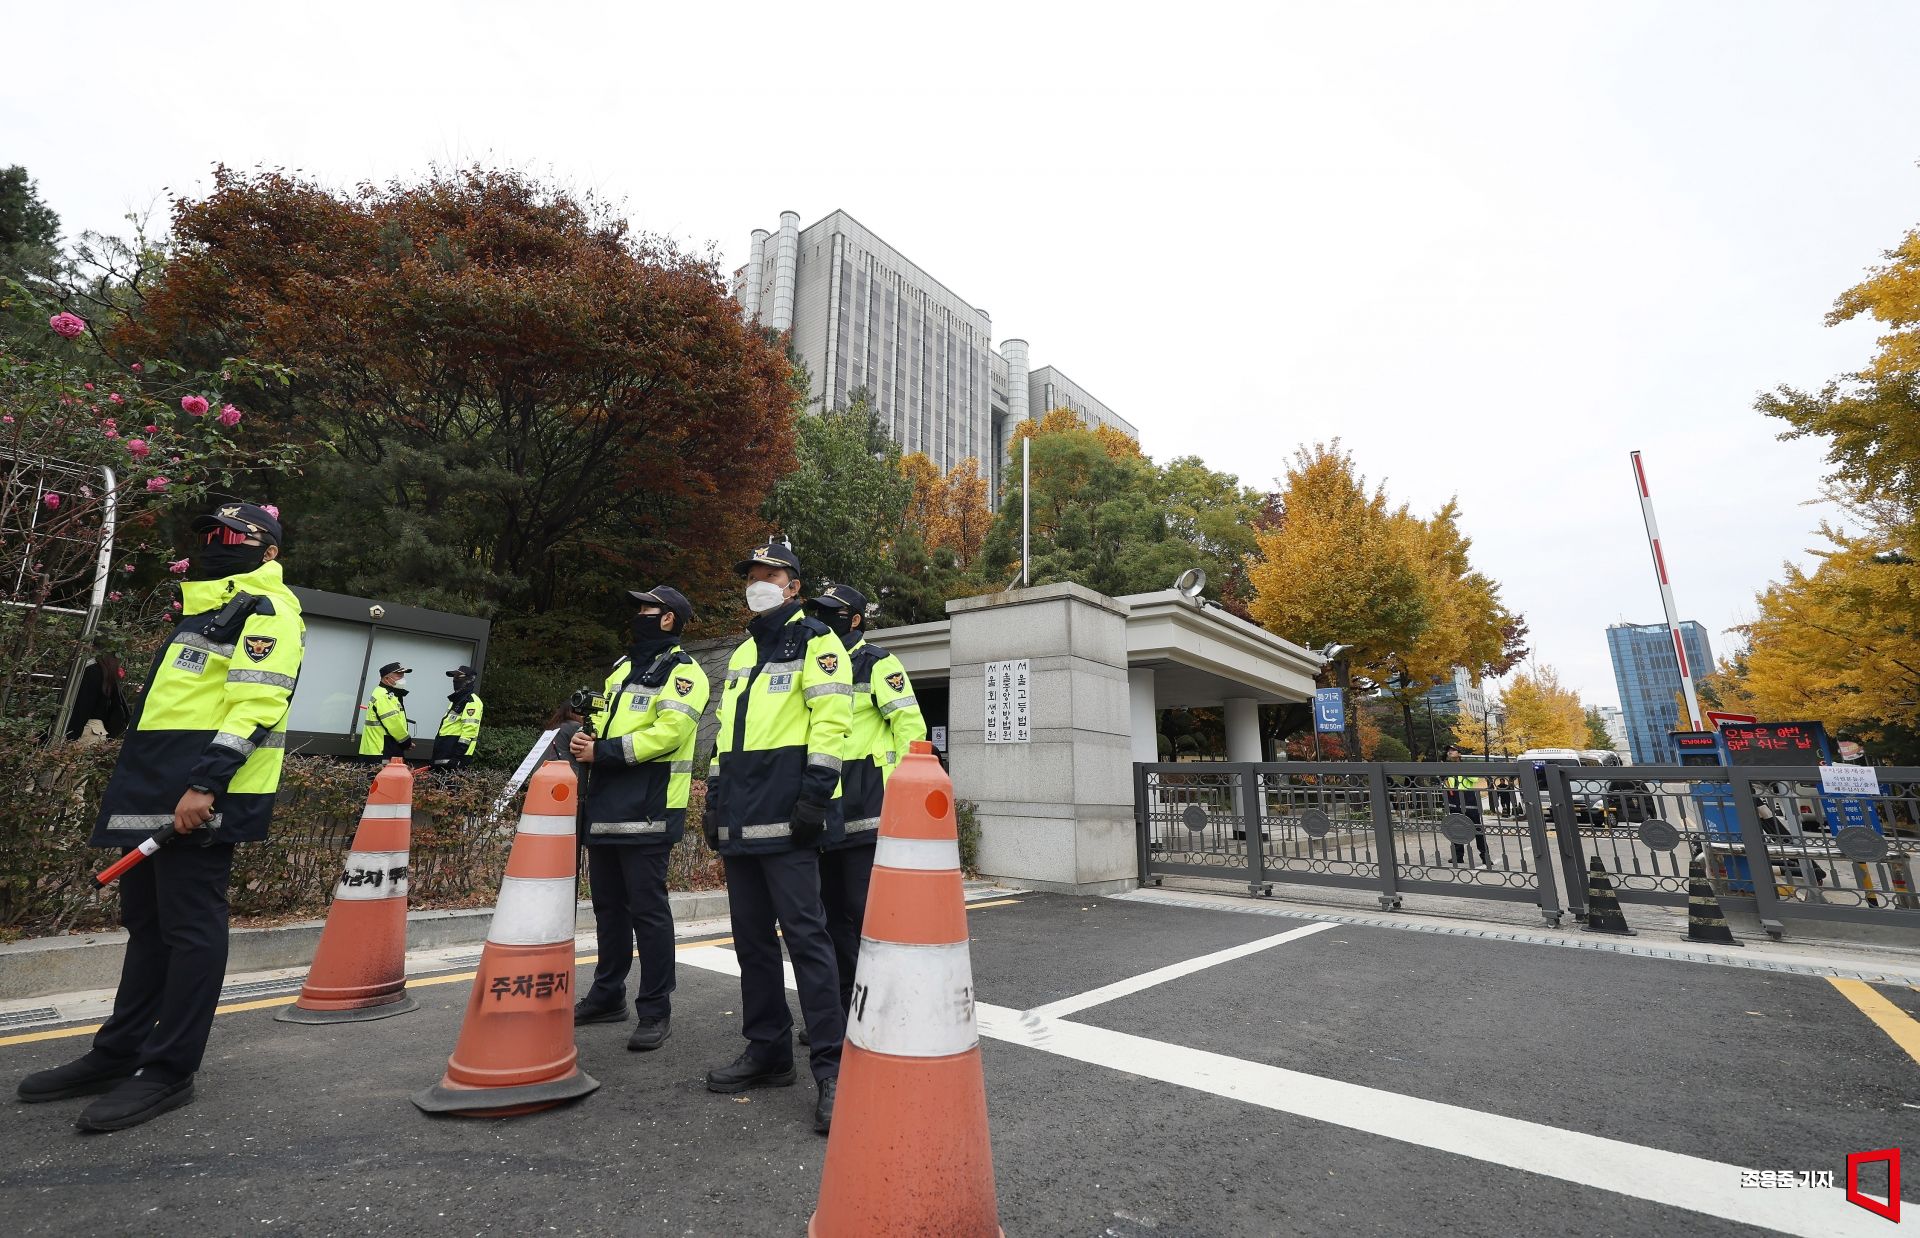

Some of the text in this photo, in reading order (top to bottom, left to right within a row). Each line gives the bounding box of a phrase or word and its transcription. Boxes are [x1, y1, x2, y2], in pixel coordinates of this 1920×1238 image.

[987, 664, 997, 741] 서울회생법원
[1002, 663, 1012, 741] 서울중앙지방법원
[1017, 662, 1027, 741] 서울고등법원
[1725, 728, 1769, 739] 오늘은
[490, 970, 569, 1001] 주차금지
